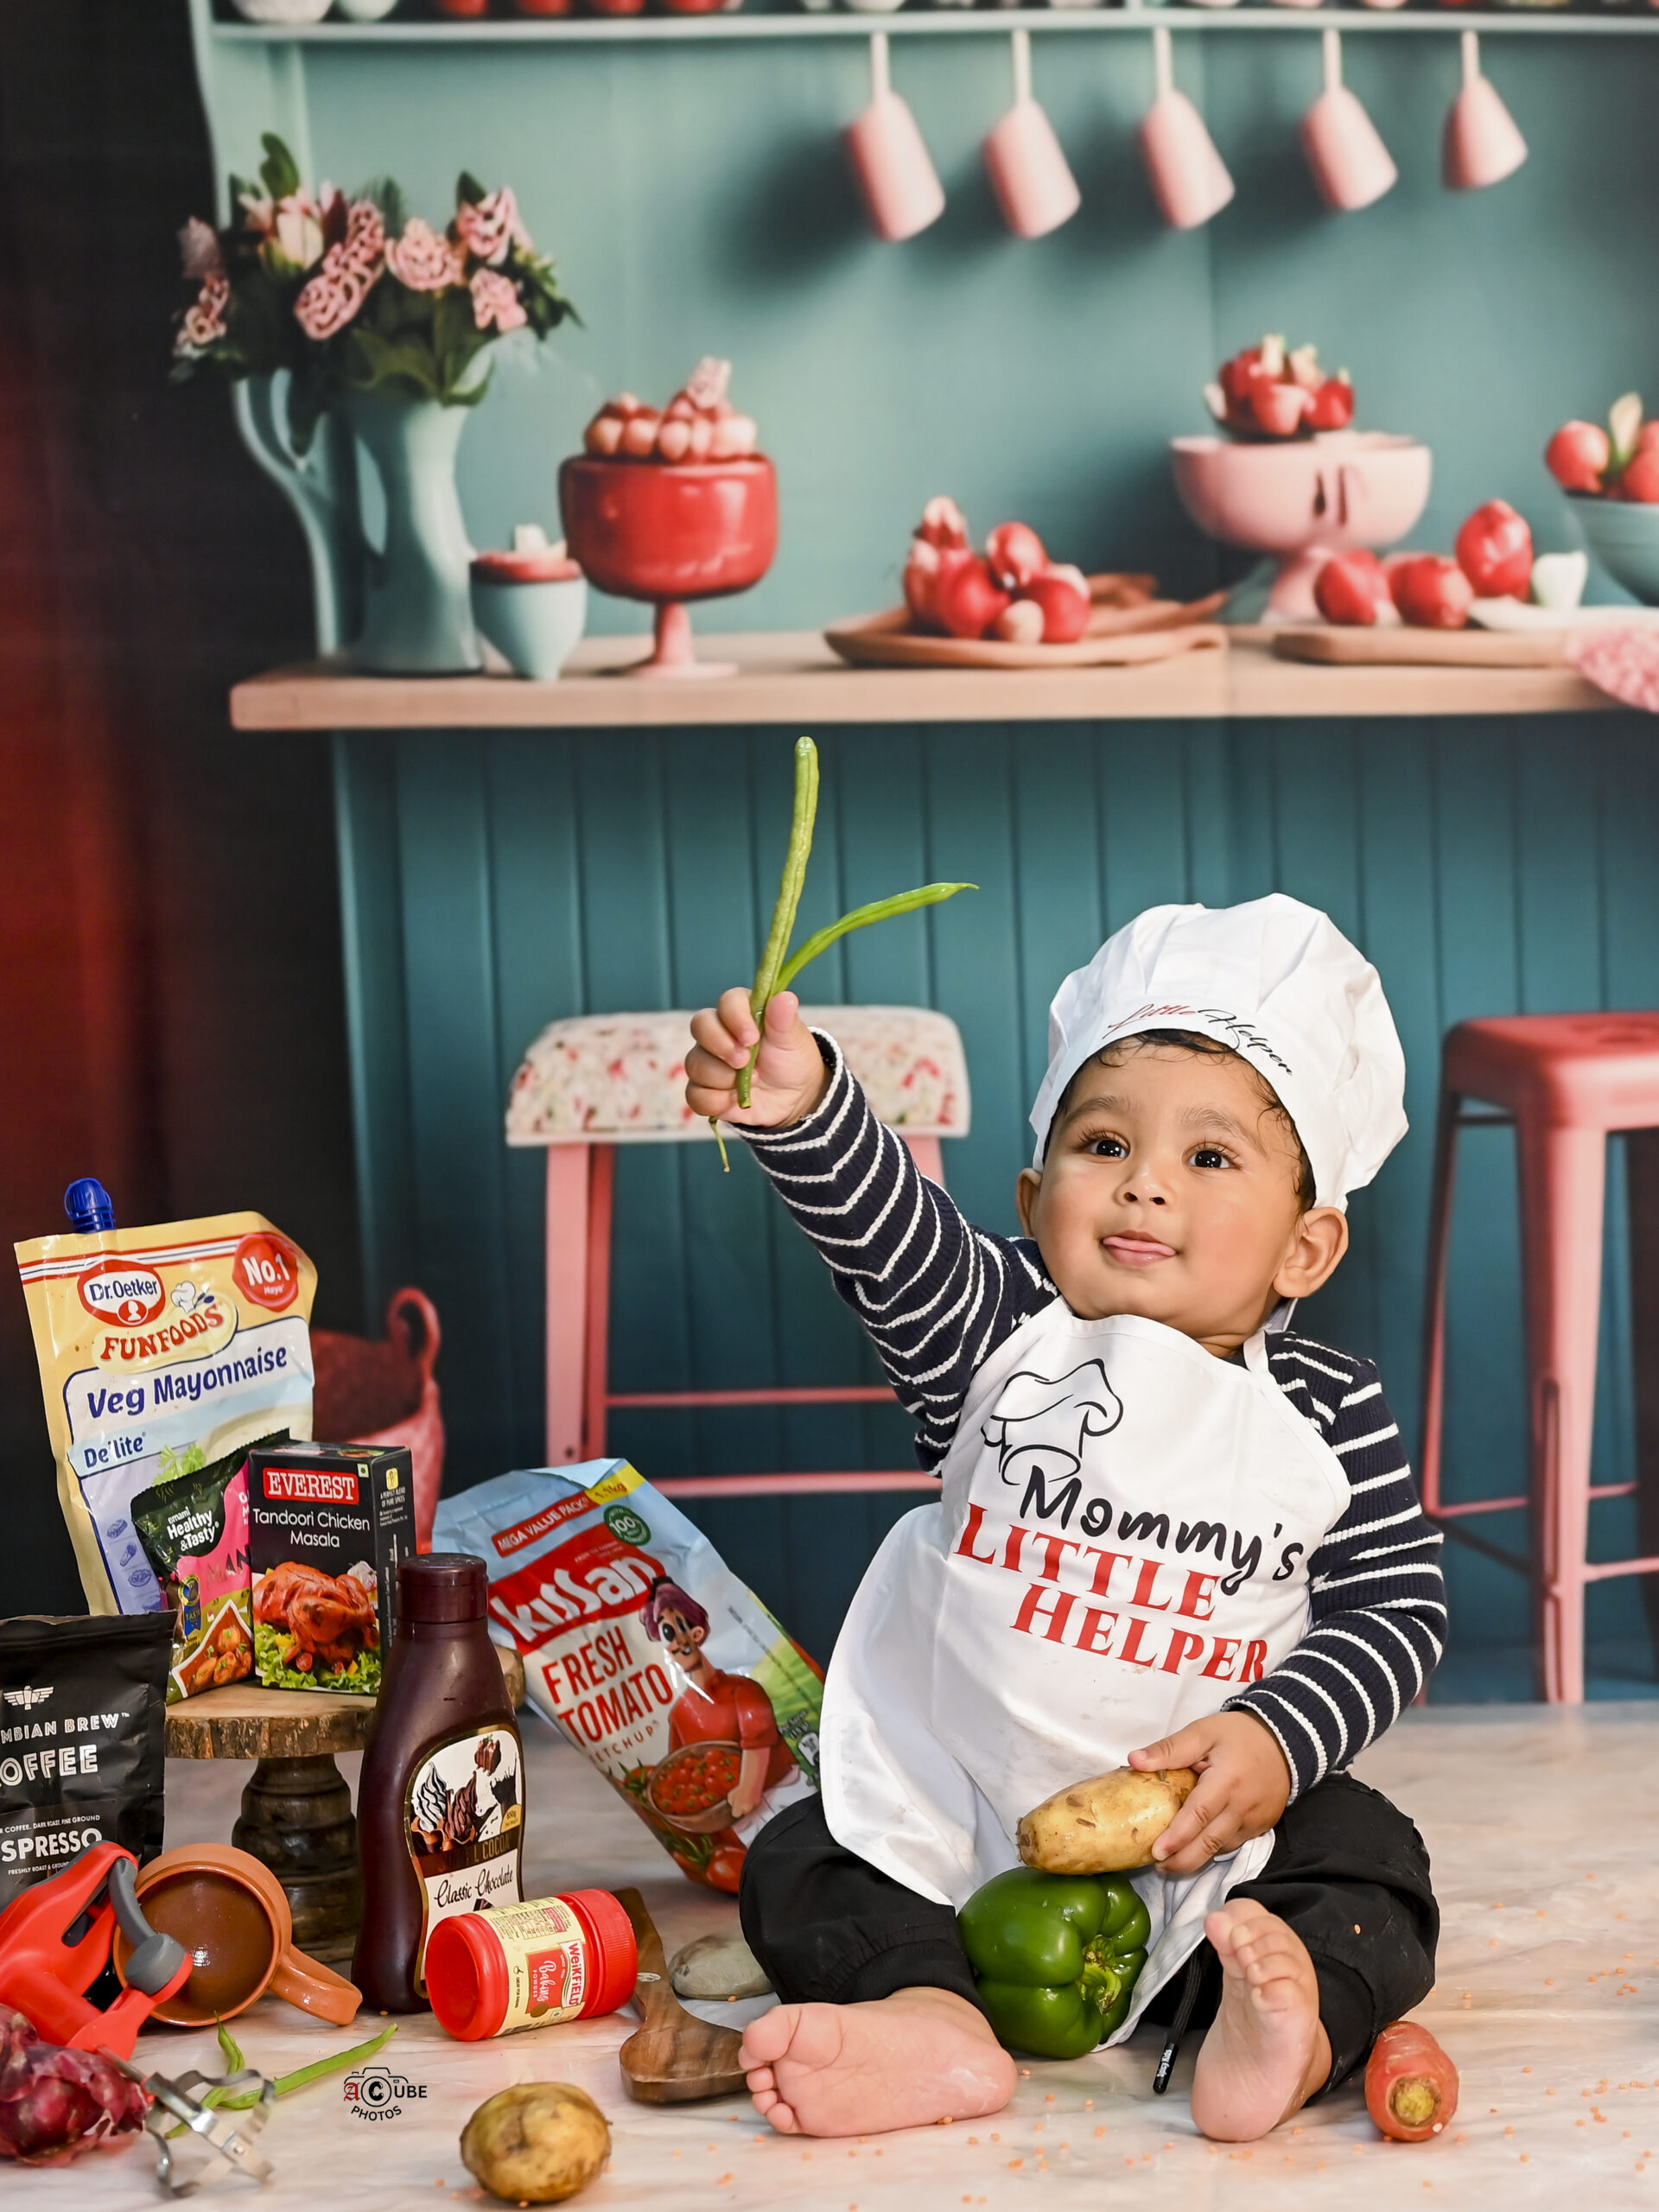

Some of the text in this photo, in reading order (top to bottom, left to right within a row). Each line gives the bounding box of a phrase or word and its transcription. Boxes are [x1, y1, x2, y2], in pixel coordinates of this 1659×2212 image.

[1198, 1009, 1293, 1076] Helper
[242, 1253, 290, 1287] No.1
[100, 1306, 225, 1361] FUNFOODS
[87, 1346, 287, 1418] Veg Mayonnaise
[267, 1471, 355, 1500] EVEREST
[167, 1510, 213, 1540] Healthy
[253, 1509, 315, 1527] Tandoori
[317, 1513, 370, 1532] Chicken
[290, 1530, 340, 1548] Masala
[498, 1530, 528, 1551] MEGA
[524, 1510, 562, 1535] VALUE
[1020, 1465, 1304, 1596] Mommy's
[954, 1503, 1222, 1621] LITTLE
[1009, 1583, 1268, 1683] HELPER
[542, 1625, 633, 1704] FRESH
[558, 1663, 673, 1747] TOMATO
[0, 1745, 99, 1787] OFFEE
[72, 1815, 100, 1823] GROUND
[482, 1833, 511, 1860] COCOA
[434, 1879, 473, 1908] Classic
[475, 1864, 513, 1897] Chocolate
[537, 1960, 556, 2002] Baking
